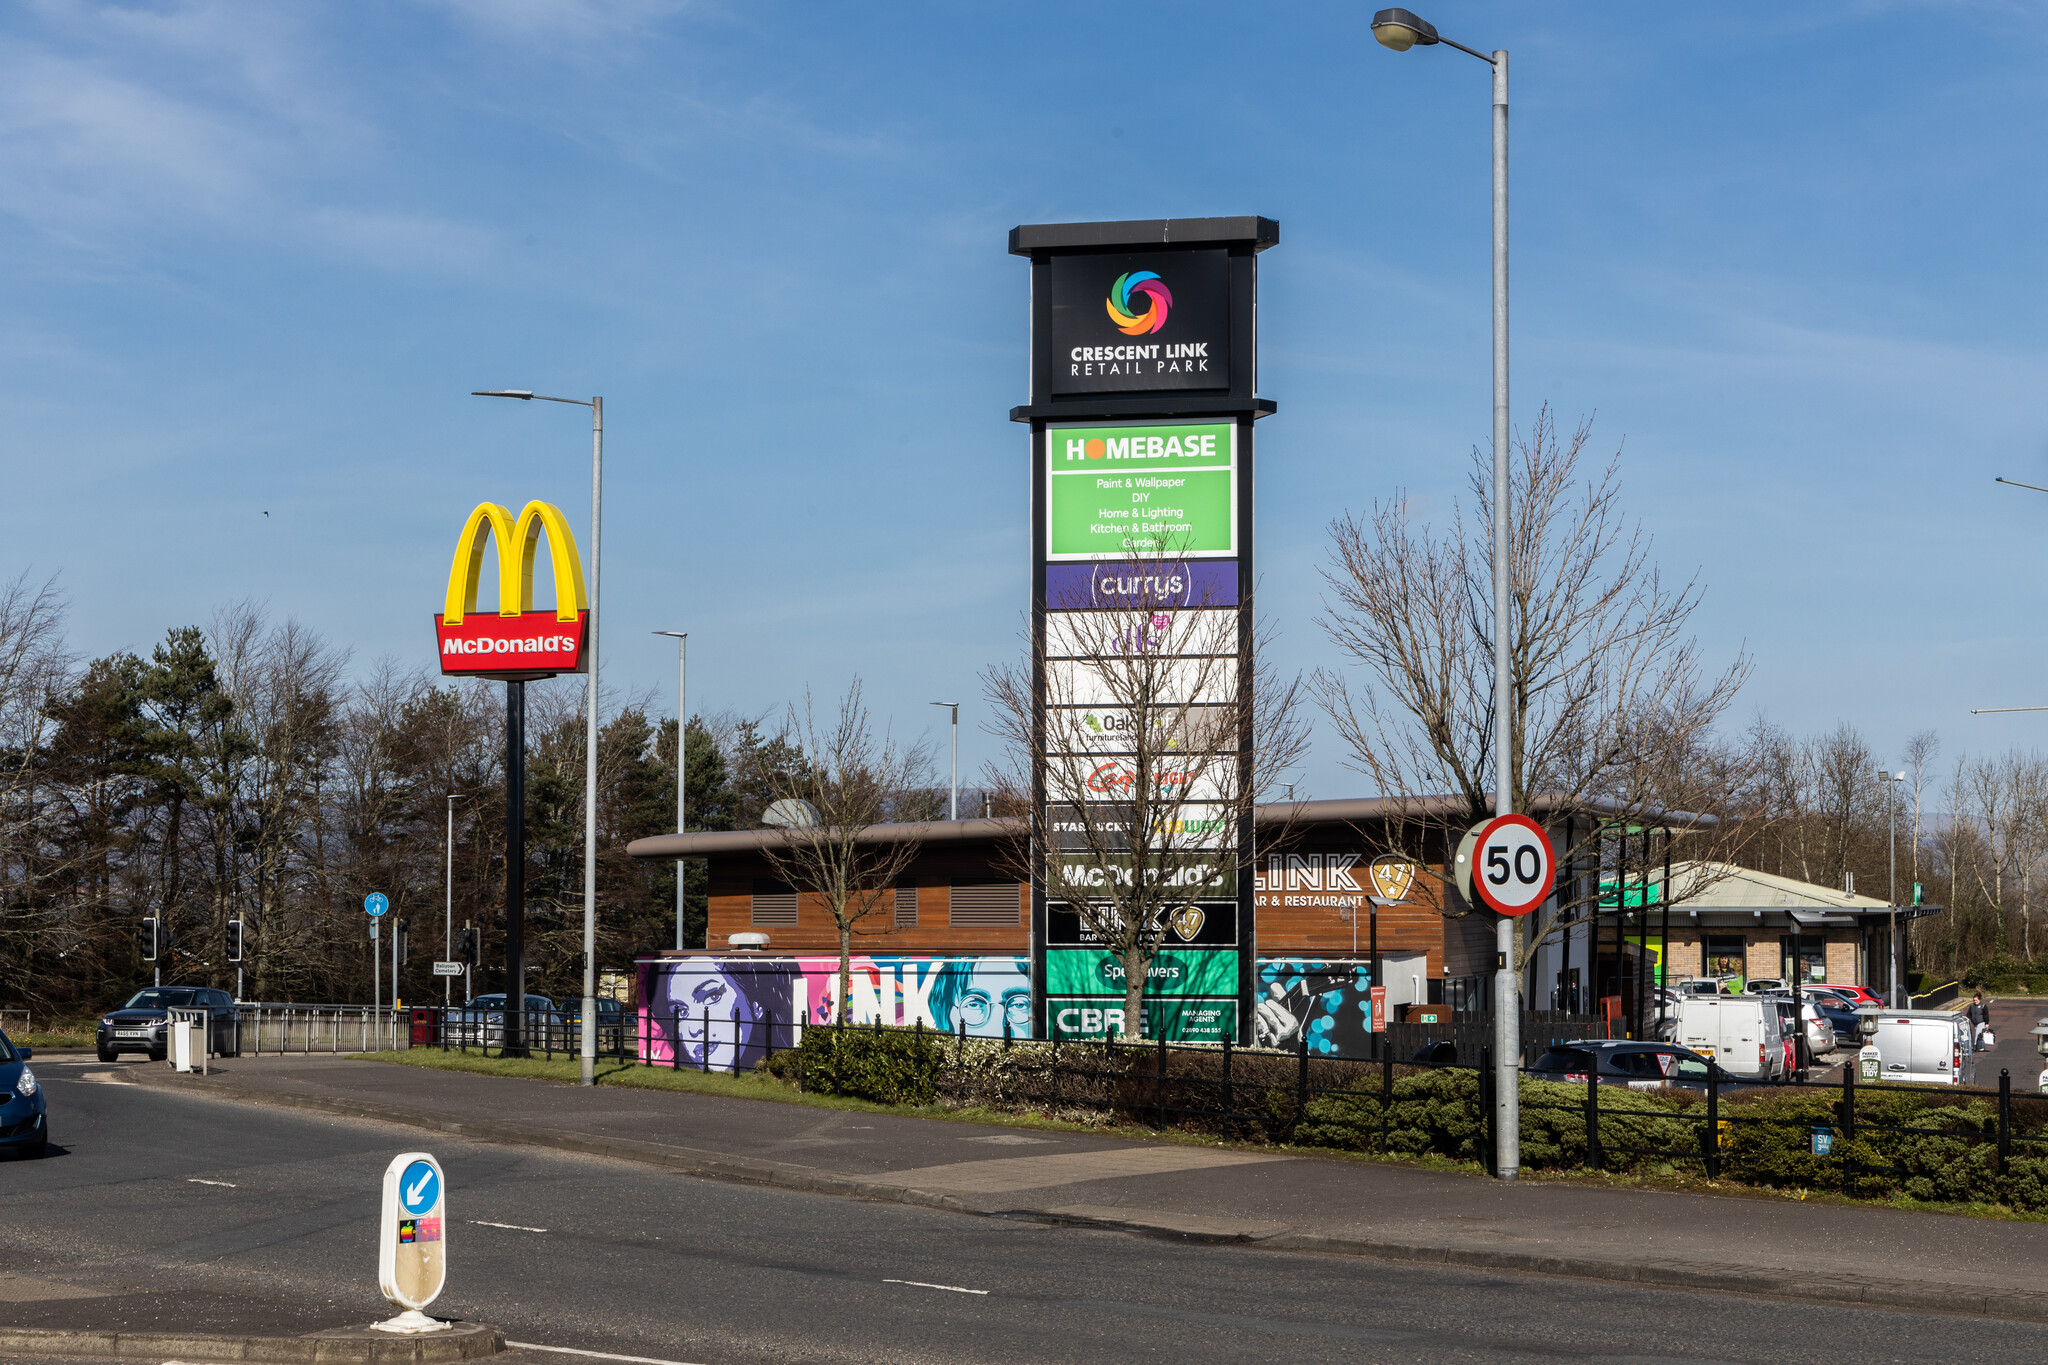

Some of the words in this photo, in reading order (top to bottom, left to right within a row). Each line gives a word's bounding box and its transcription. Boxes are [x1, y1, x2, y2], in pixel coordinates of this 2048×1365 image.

[1071, 345, 1160, 362] CRESCENT
[1166, 342, 1209, 359] LINK
[1071, 362, 1141, 376] RETAIL
[1157, 359, 1209, 373] PARK
[1066, 434, 1216, 461] HOMEBASE
[1096, 477, 1123, 488] Paint
[1125, 478, 1133, 488] &
[1135, 476, 1186, 489] Wallpaper
[1132, 492, 1150, 503] DIY
[1099, 508, 1129, 518] Home
[1132, 508, 1139, 518] &
[1141, 507, 1184, 520] Lighting
[1090, 523, 1130, 534] Kitchen
[1132, 523, 1140, 533] &
[1142, 522, 1192, 533] Bathroom
[1122, 537, 1160, 548] Garden
[1100, 575, 1184, 601] currys
[443, 635, 575, 655] McDonald's
[1103, 715, 1136, 731] Oak
[1053, 821, 1131, 832] STARUCKS
[1487, 844, 1541, 886] 50
[1378, 863, 1406, 882] 47
[1271, 896, 1281, 906] &
[1284, 895, 1364, 907] RESTAURANT
[1079, 933, 1098, 941] BAR
[1104, 963, 1179, 981] Spevers
[1181, 1009, 1222, 1017] MANAGING
[1211, 1026, 1222, 1034] 555
[1817, 1134, 1828, 1144] SV
